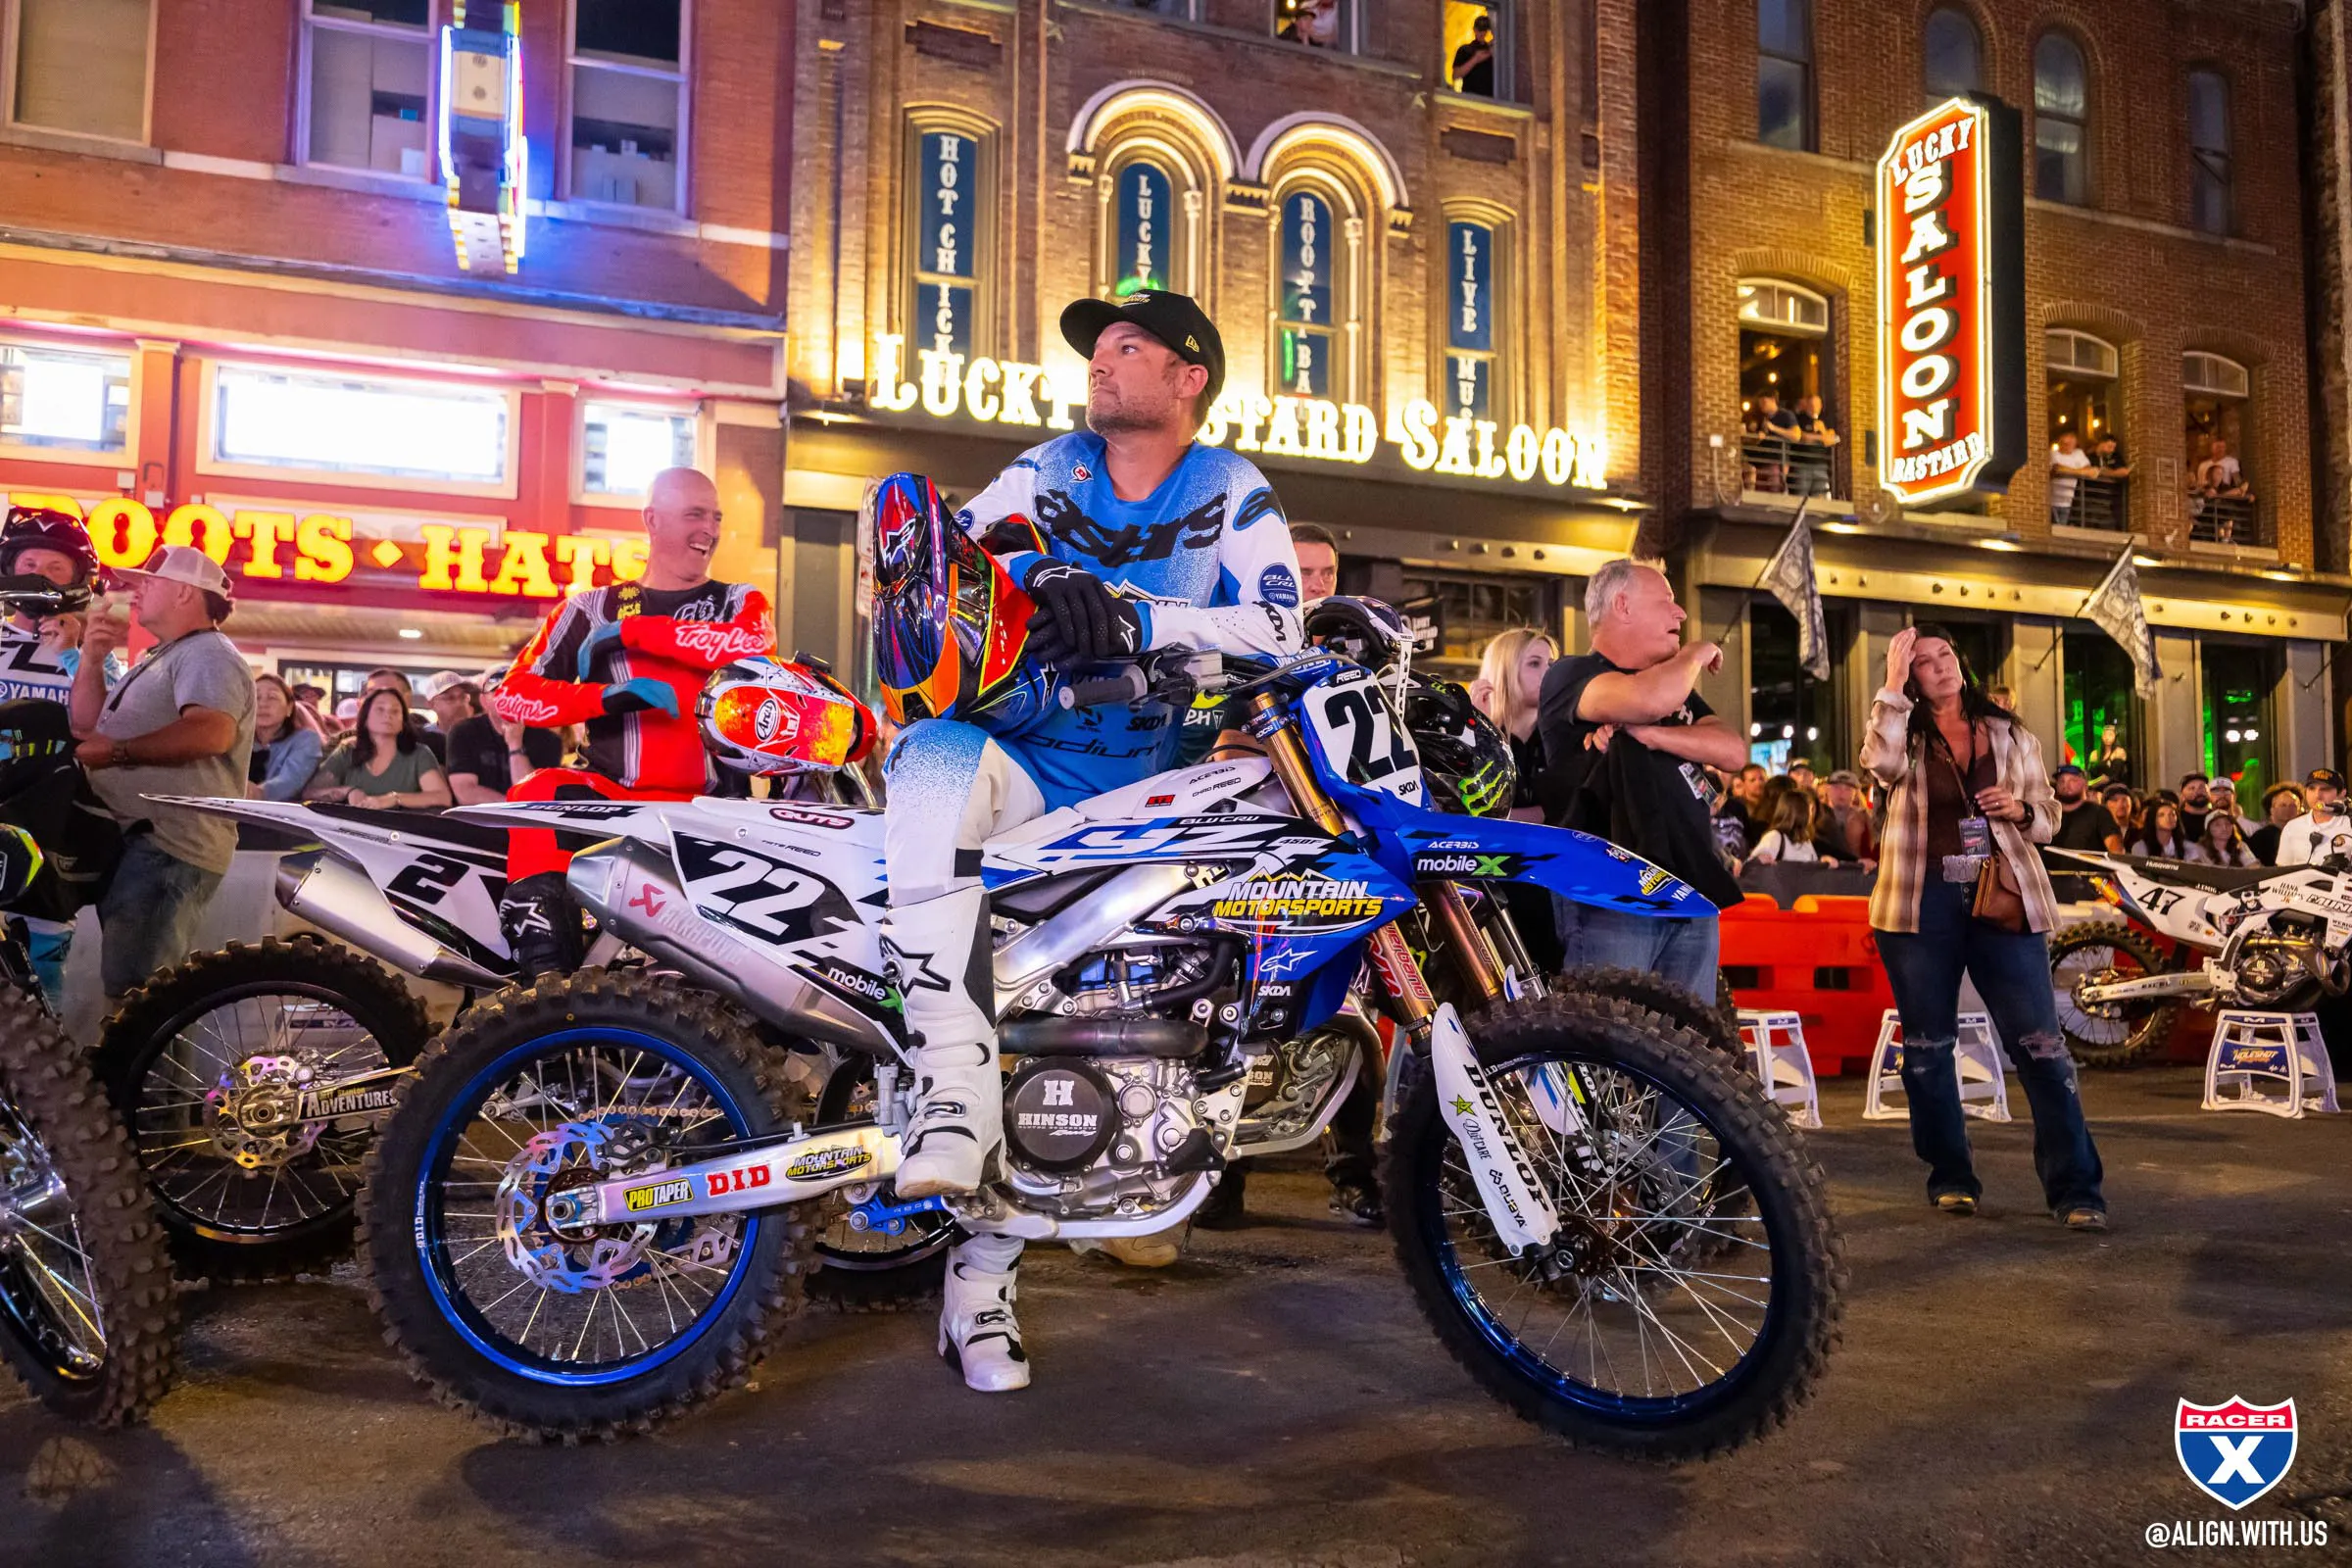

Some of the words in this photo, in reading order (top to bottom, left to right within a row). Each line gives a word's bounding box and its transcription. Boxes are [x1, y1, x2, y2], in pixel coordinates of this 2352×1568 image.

[1889, 117, 1975, 187] LUCKY
[937, 134, 959, 216] HOT
[1137, 174, 1152, 288] LUCKY
[934, 222, 956, 355] CHICK
[1461, 229, 1478, 332] LIVE
[1900, 160, 1950, 450] SALOON
[870, 333, 1088, 431] LUCKY
[1194, 394, 1378, 464] STARD
[1401, 399, 1608, 490] SALOON
[1891, 431, 1985, 482] BASTARD
[9, 492, 355, 584] OOTS
[9, 682, 71, 706] YAMAH
[1336, 669, 1362, 684] REED
[757, 700, 777, 742] Arai
[1324, 684, 1419, 783] 22
[1212, 777, 1242, 791] REED
[531, 804, 624, 814] DUNLOP
[773, 808, 852, 828] GUTS
[785, 844, 822, 858] REED
[387, 854, 471, 906] 2
[686, 850, 826, 936] 22
[1229, 881, 1369, 900] MOUNTAIN
[1213, 899, 1384, 917] MOTORSPORTS
[2138, 887, 2186, 916] 47
[2306, 893, 2352, 914] MUN
[1258, 986, 1292, 996] SKDA
[1017, 1113, 1098, 1127] HINSON
[1463, 1063, 1550, 1212] DUNLOP
[794, 1146, 863, 1168] MOUNTAIN
[709, 1164, 771, 1197] D.I.D
